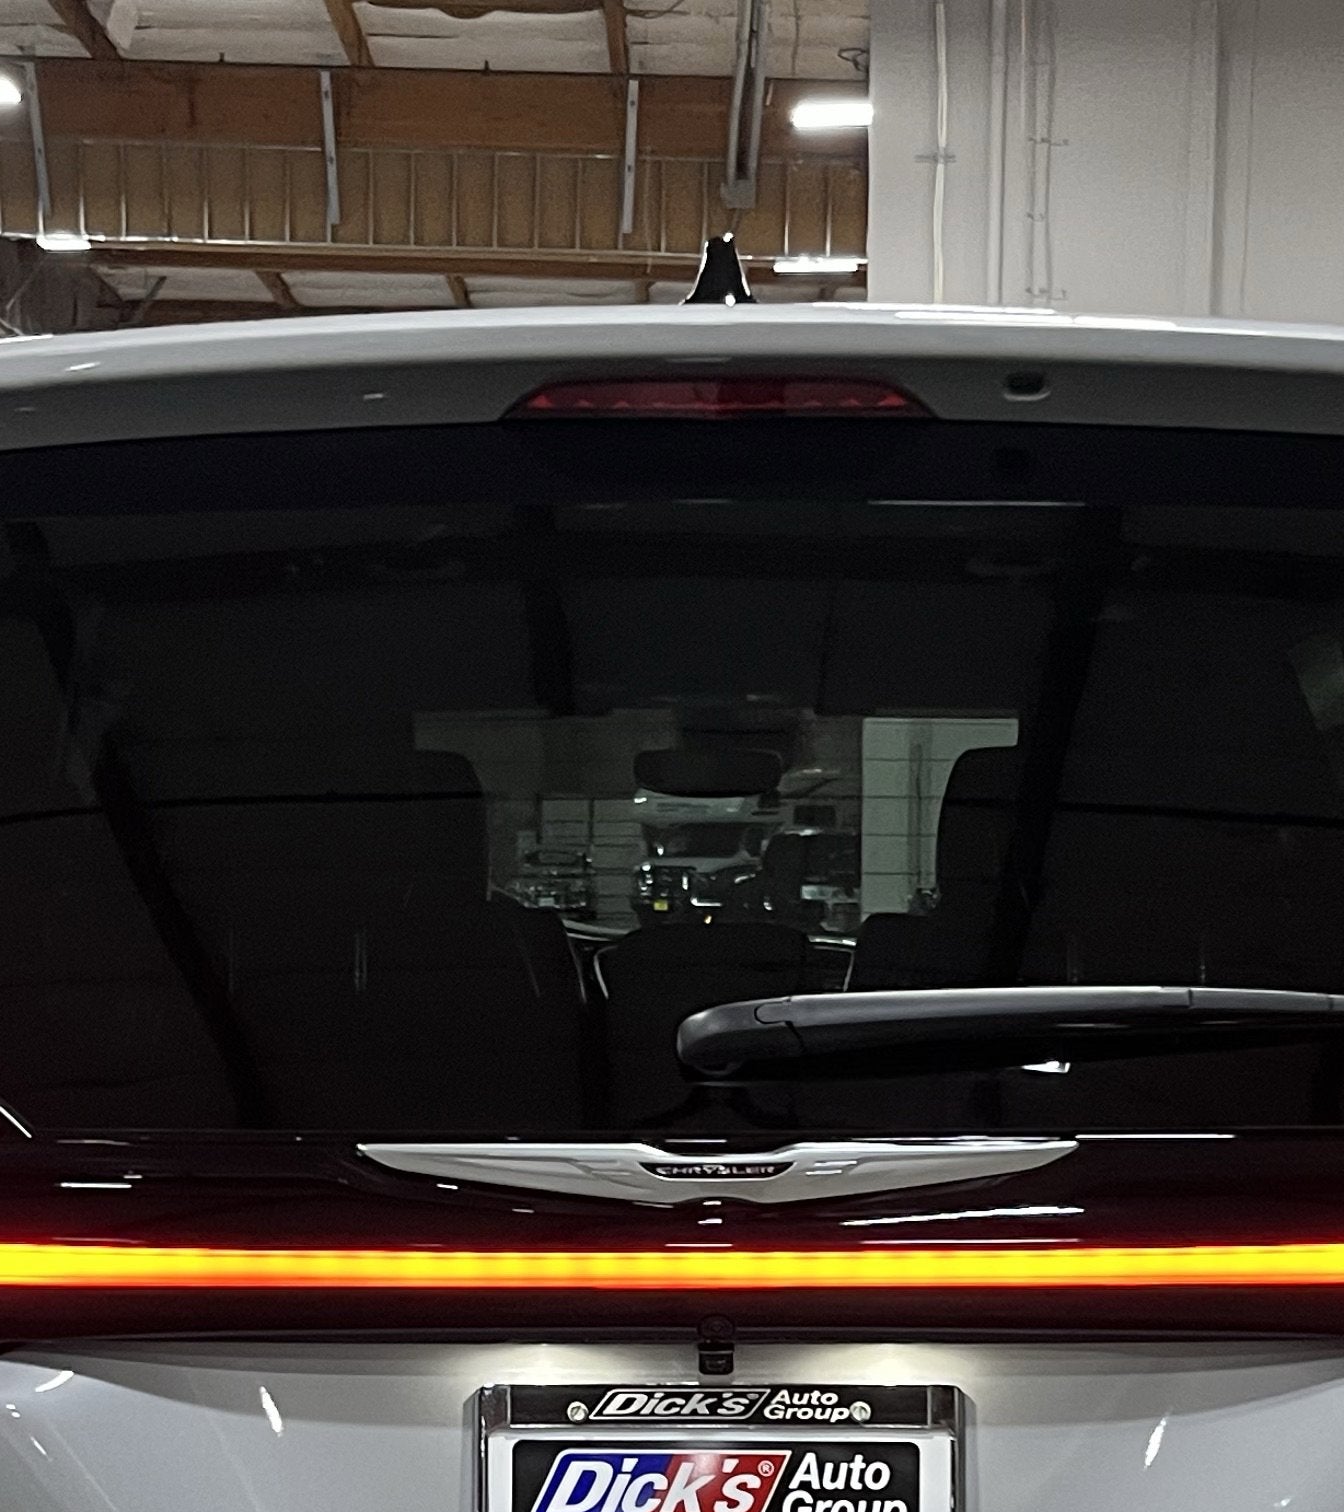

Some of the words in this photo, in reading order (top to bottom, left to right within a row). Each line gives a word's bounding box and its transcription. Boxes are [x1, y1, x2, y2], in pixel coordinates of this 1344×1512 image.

[602, 1390, 752, 1419] Dick's
[774, 1389, 839, 1406] Auto
[763, 1404, 850, 1423] Group
[788, 1453, 890, 1491] Auto
